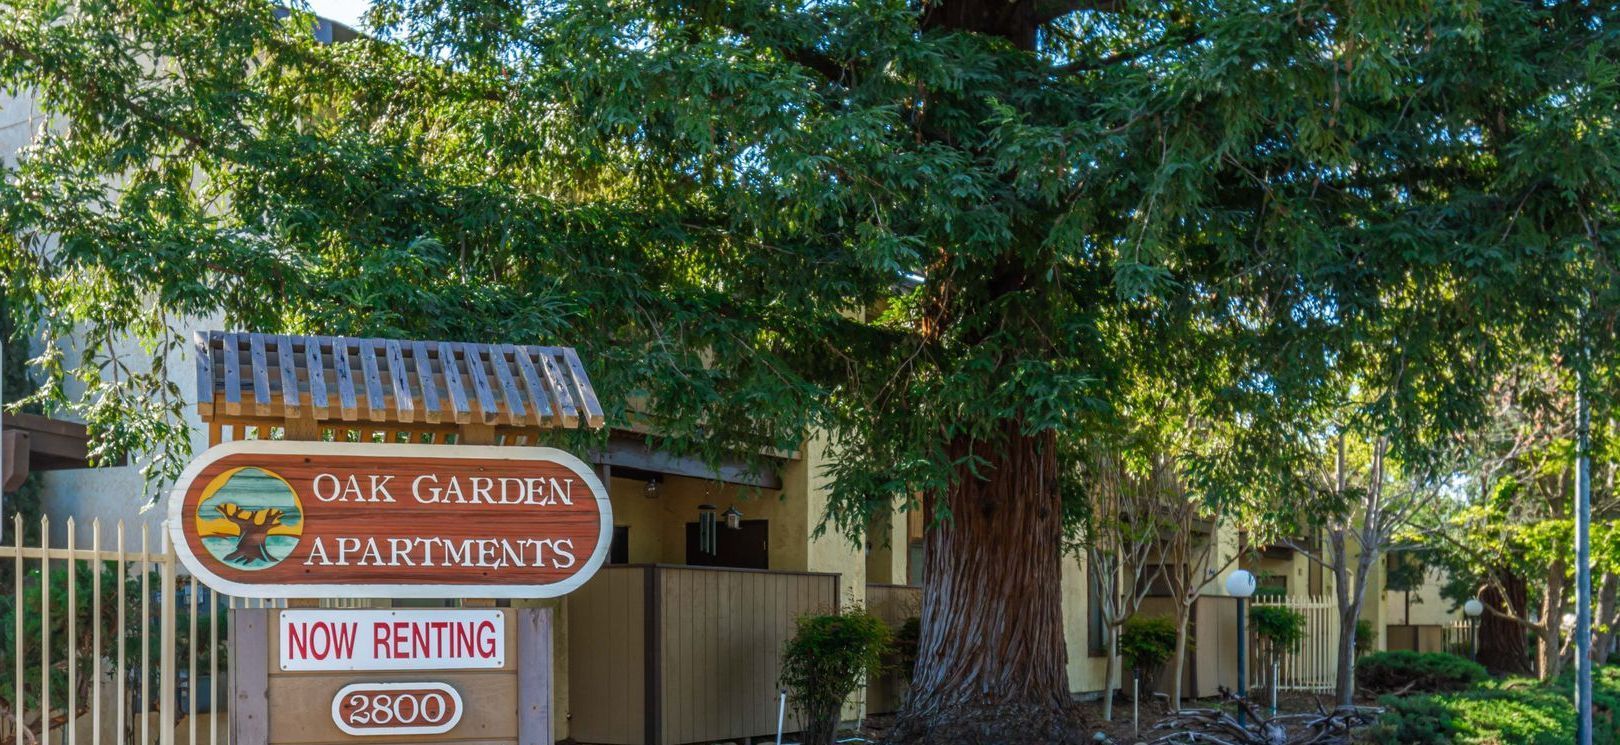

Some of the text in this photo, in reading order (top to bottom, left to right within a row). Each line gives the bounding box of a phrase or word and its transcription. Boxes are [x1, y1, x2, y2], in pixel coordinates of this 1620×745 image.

[312, 473, 574, 506] OAK GARDEN
[303, 537, 576, 570] APARTMENTS
[288, 620, 497, 660] NOW RENTING
[349, 693, 446, 724] 2800
